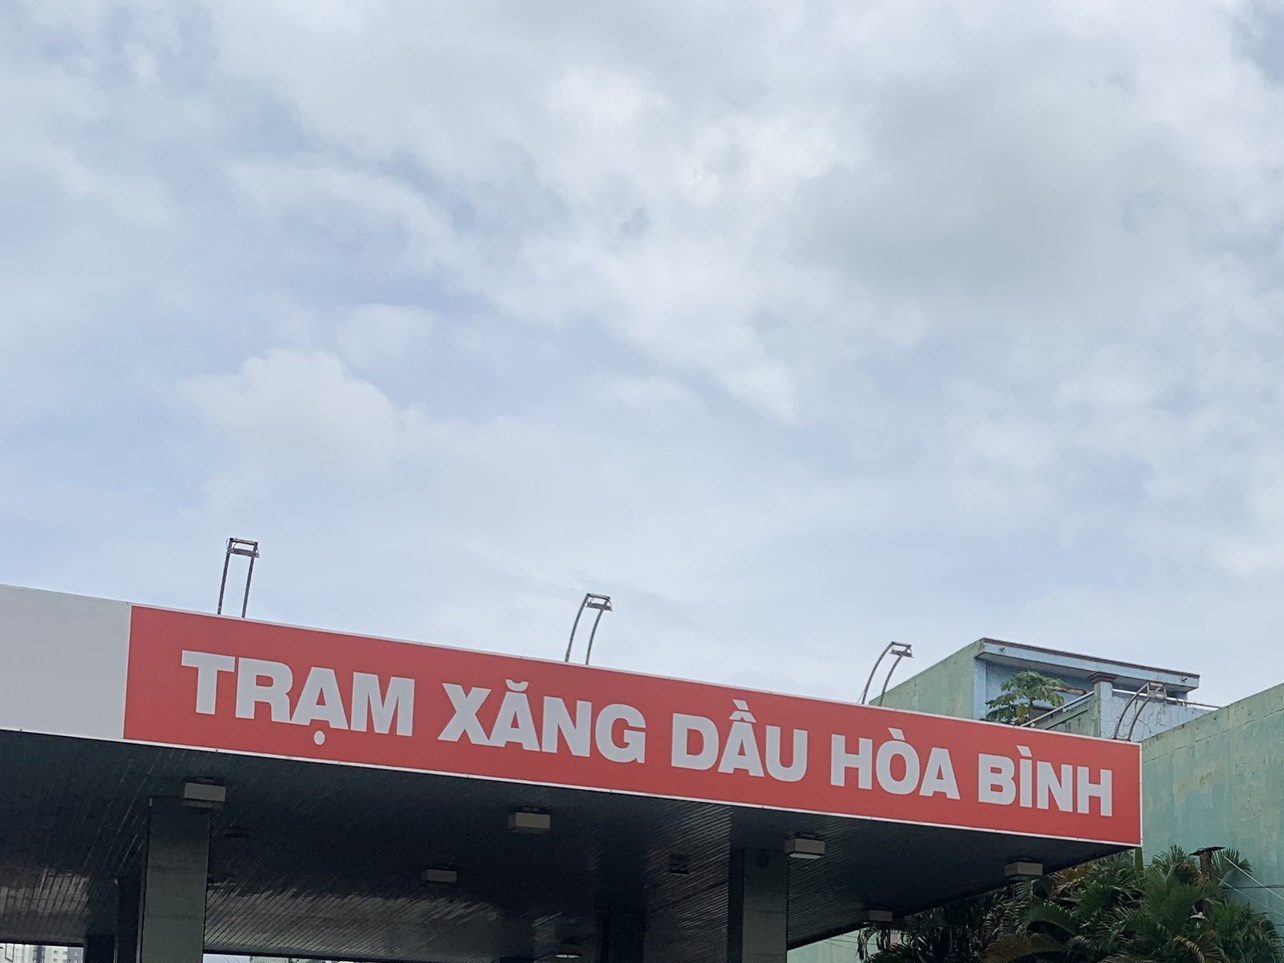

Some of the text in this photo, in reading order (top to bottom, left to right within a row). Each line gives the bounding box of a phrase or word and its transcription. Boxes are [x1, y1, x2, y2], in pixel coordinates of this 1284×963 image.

[180, 650, 1113, 817] TRẠM XĂNG DẦU HÒA BÌNH
